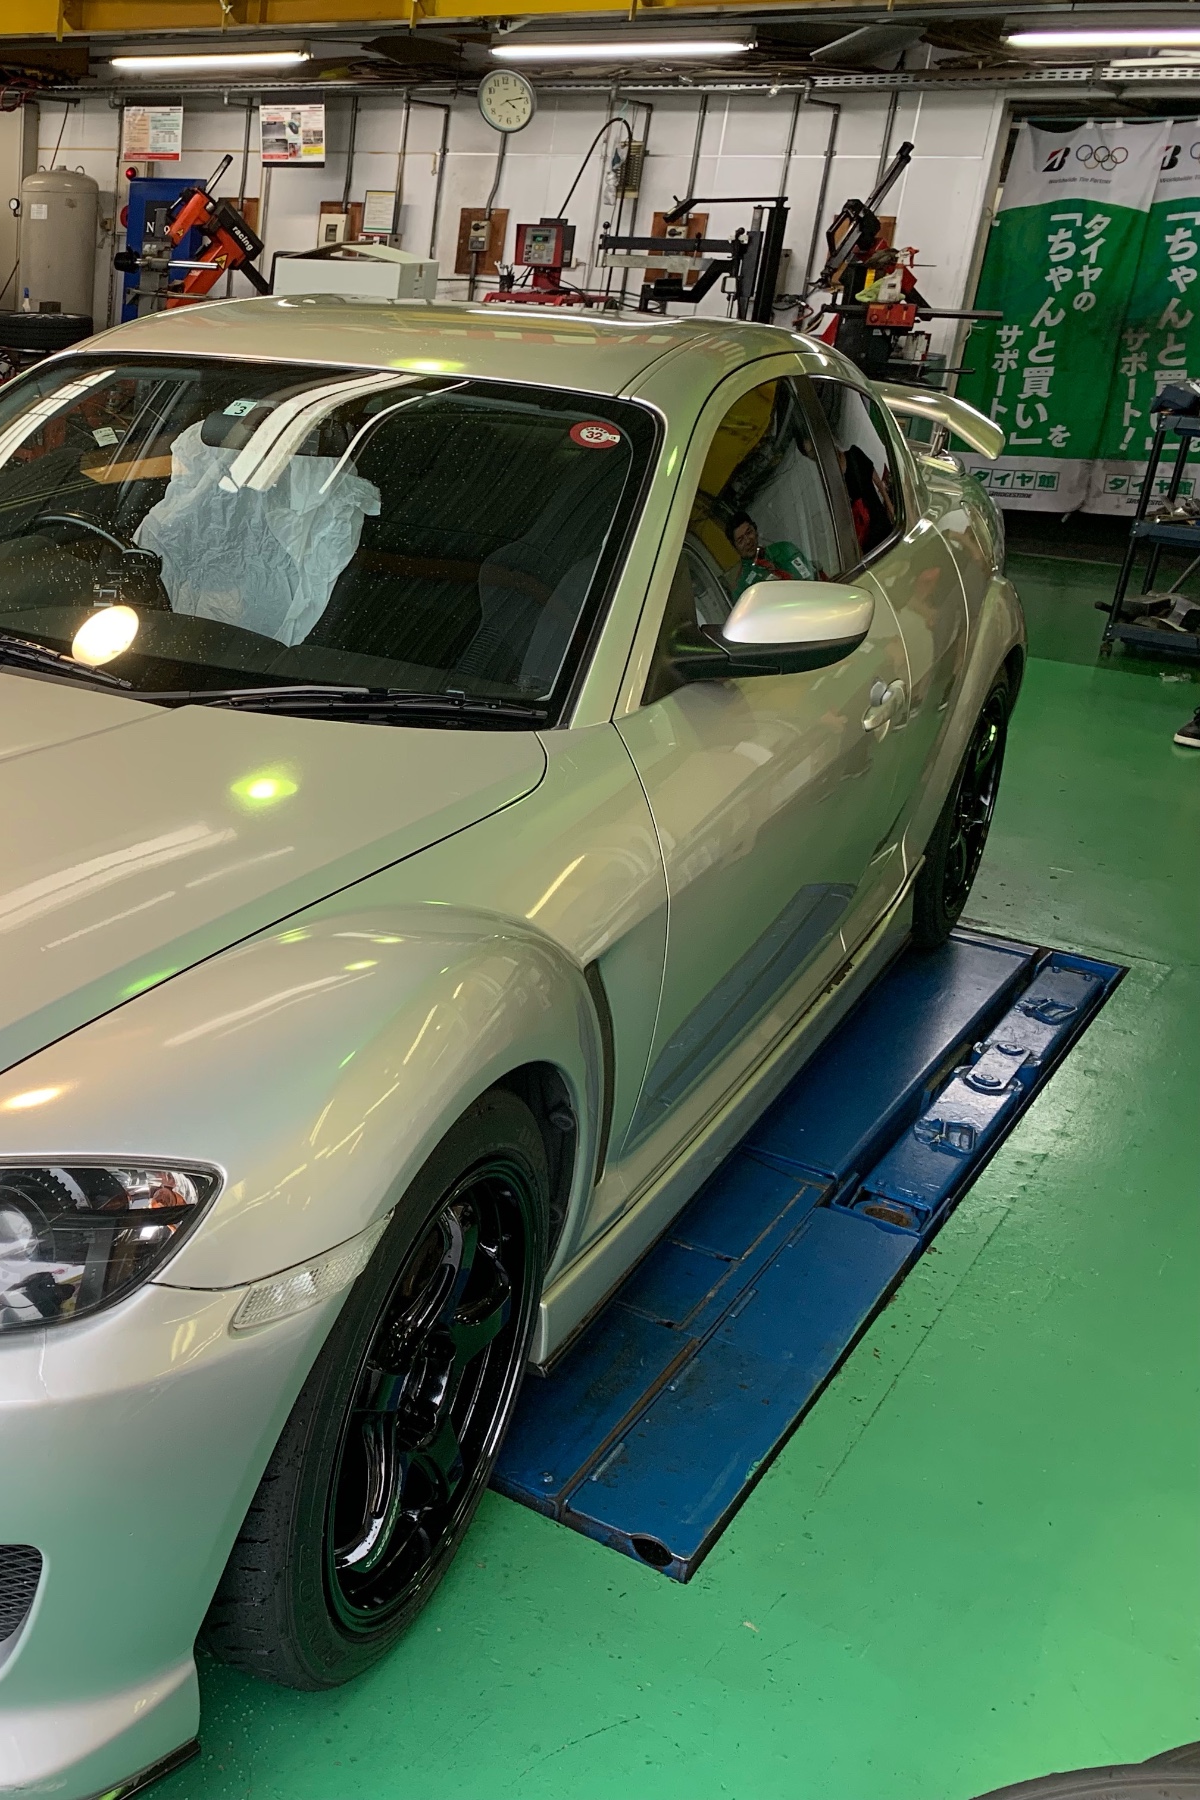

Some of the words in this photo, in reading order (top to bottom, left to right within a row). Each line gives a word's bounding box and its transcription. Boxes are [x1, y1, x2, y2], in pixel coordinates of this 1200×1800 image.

[493, 79, 500, 87] 11
[502, 76, 509, 85] 12
[513, 79, 517, 87] 1
[488, 87, 495, 95] 10
[519, 87, 525, 95] 2
[523, 97, 529, 105] 3
[498, 115, 503, 123] 7
[506, 117, 512, 125] 6
[516, 115, 521, 123] 5
[231, 225, 254, 252] racing
[1072, 213, 1112, 313] タイヤの
[989, 325, 1024, 426] サポート
[234, 405, 247, 415] 3
[585, 431, 603, 440] 32
[1047, 424, 1071, 448] を
[973, 470, 1057, 489] タイヤ館
[988, 491, 1033, 499] BRIDGESTONE
